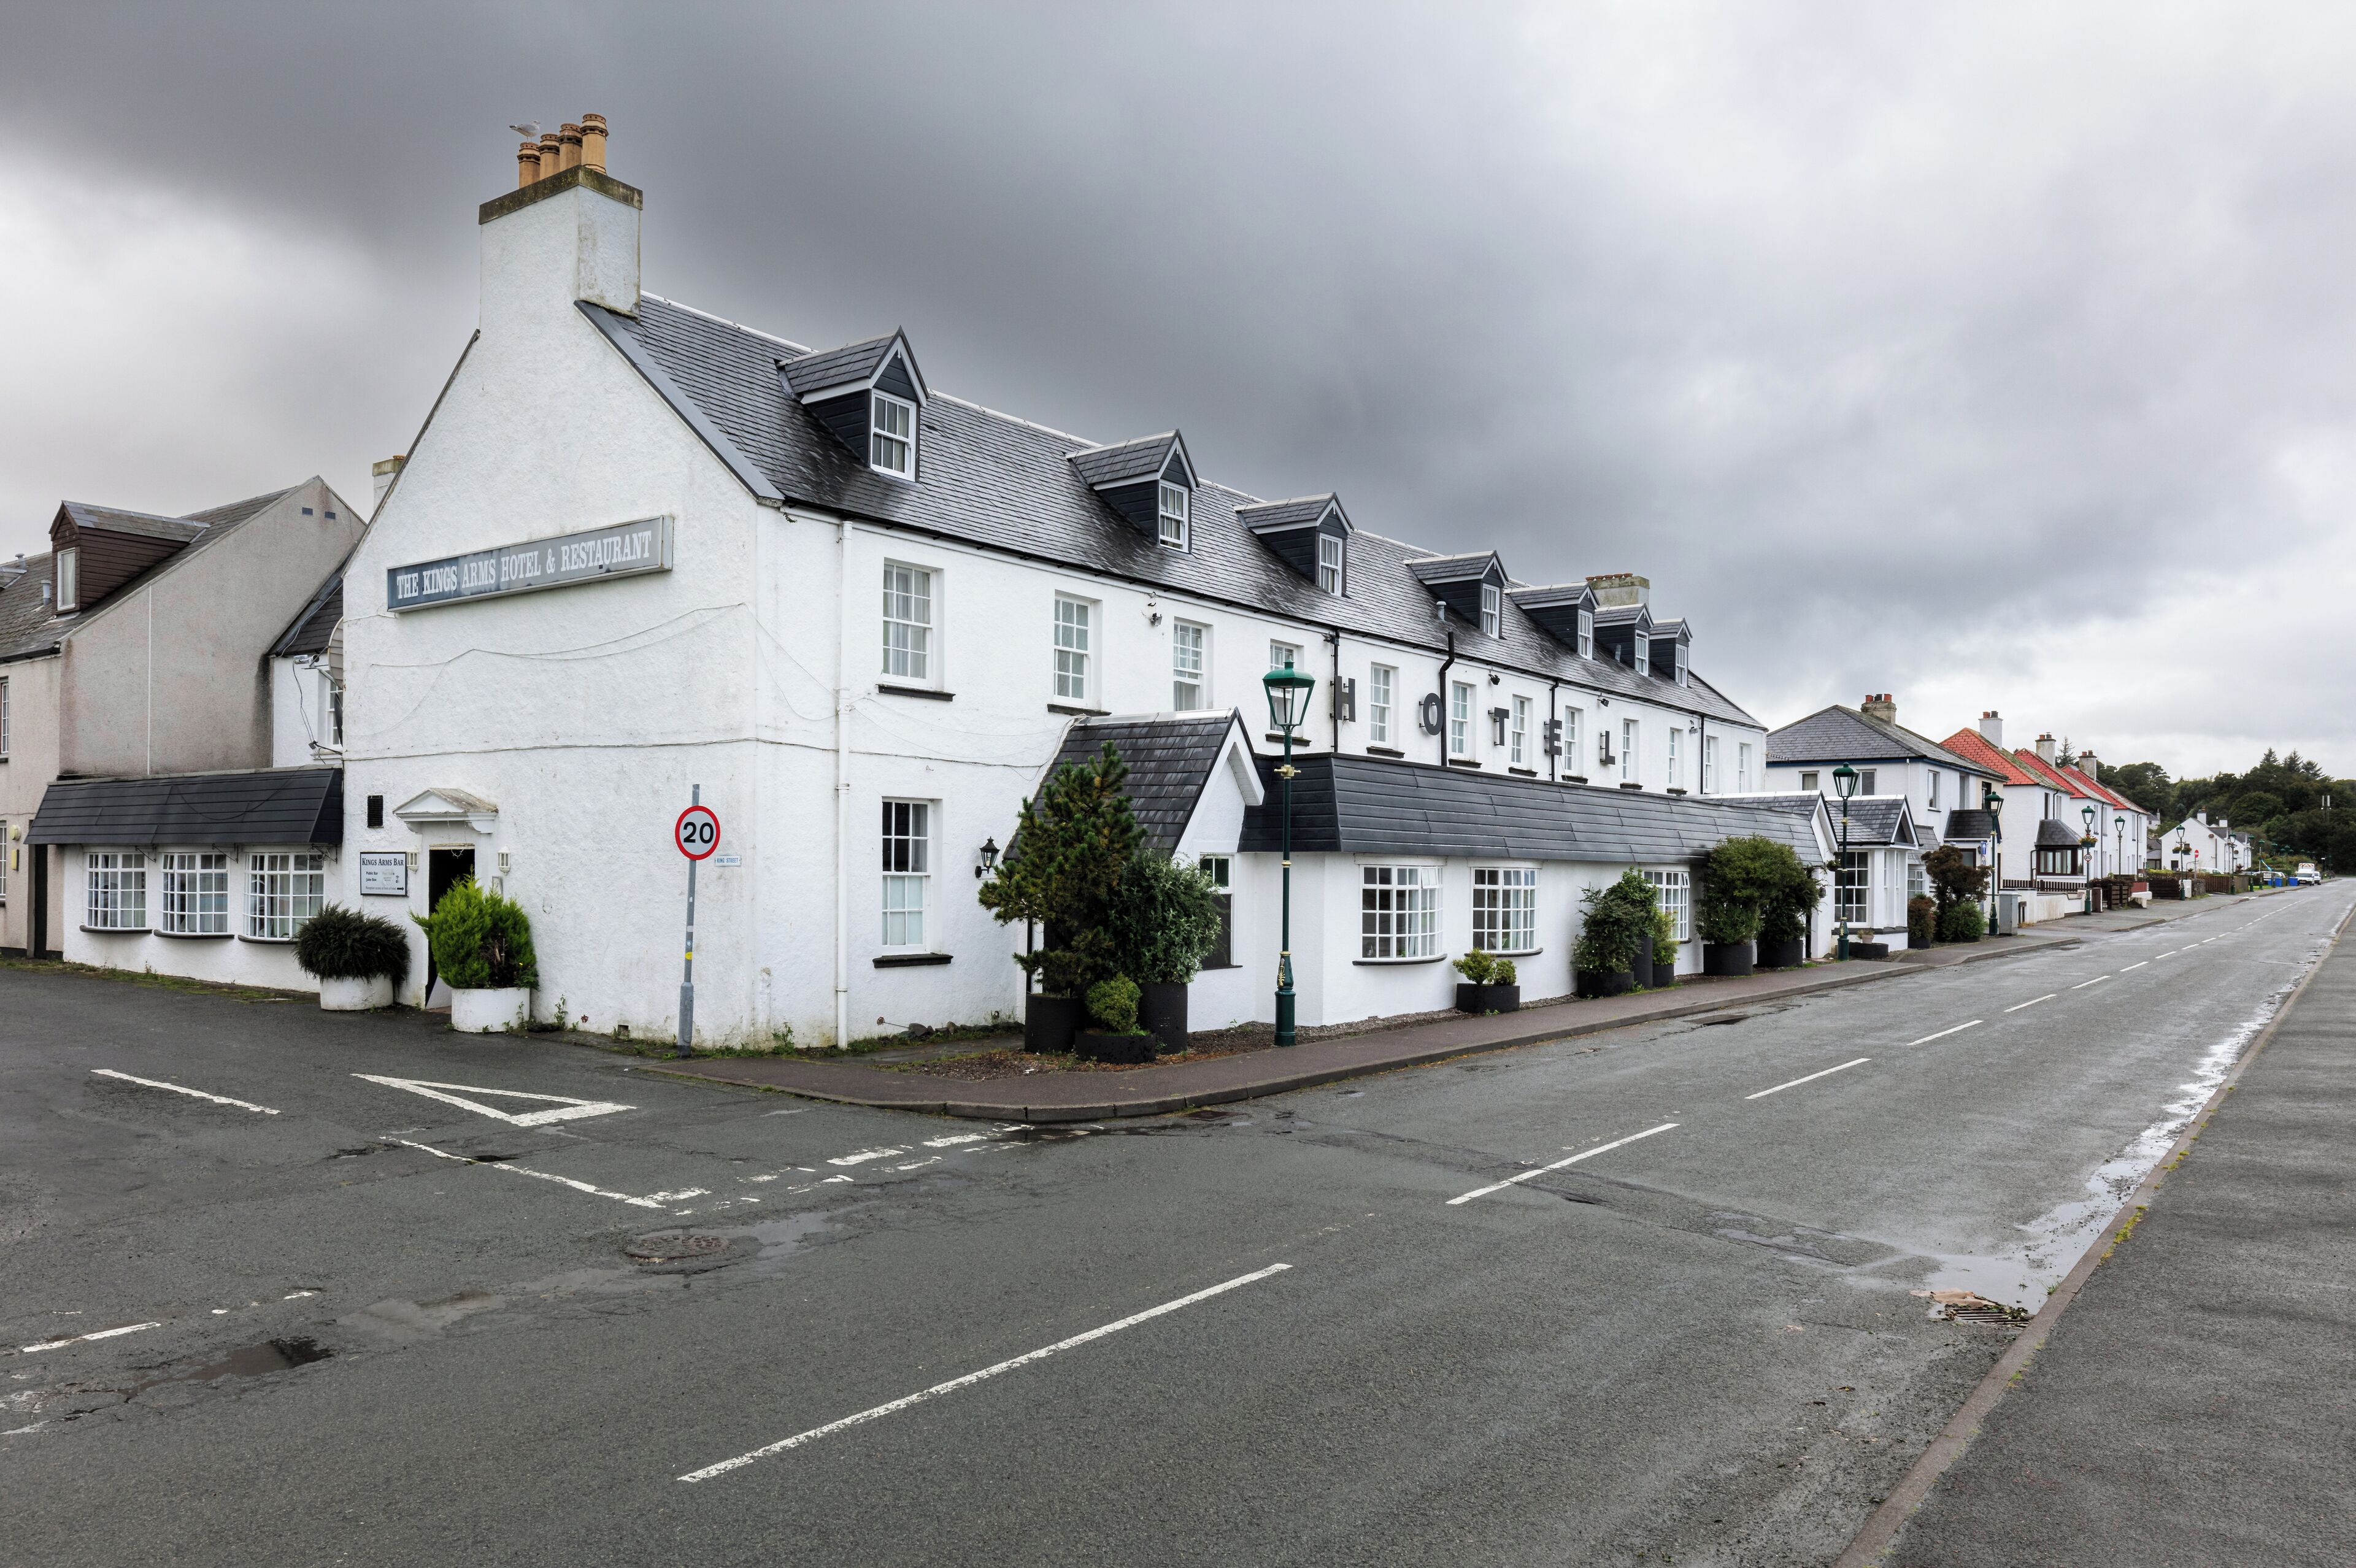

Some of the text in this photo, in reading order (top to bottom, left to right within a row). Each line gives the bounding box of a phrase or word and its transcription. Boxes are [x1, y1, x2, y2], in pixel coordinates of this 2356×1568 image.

[396, 530, 652, 599] THE KINGS ARMS HOTEL & RESTAURANT
[1334, 675, 1615, 765] HOTEL
[683, 821, 715, 844] 20
